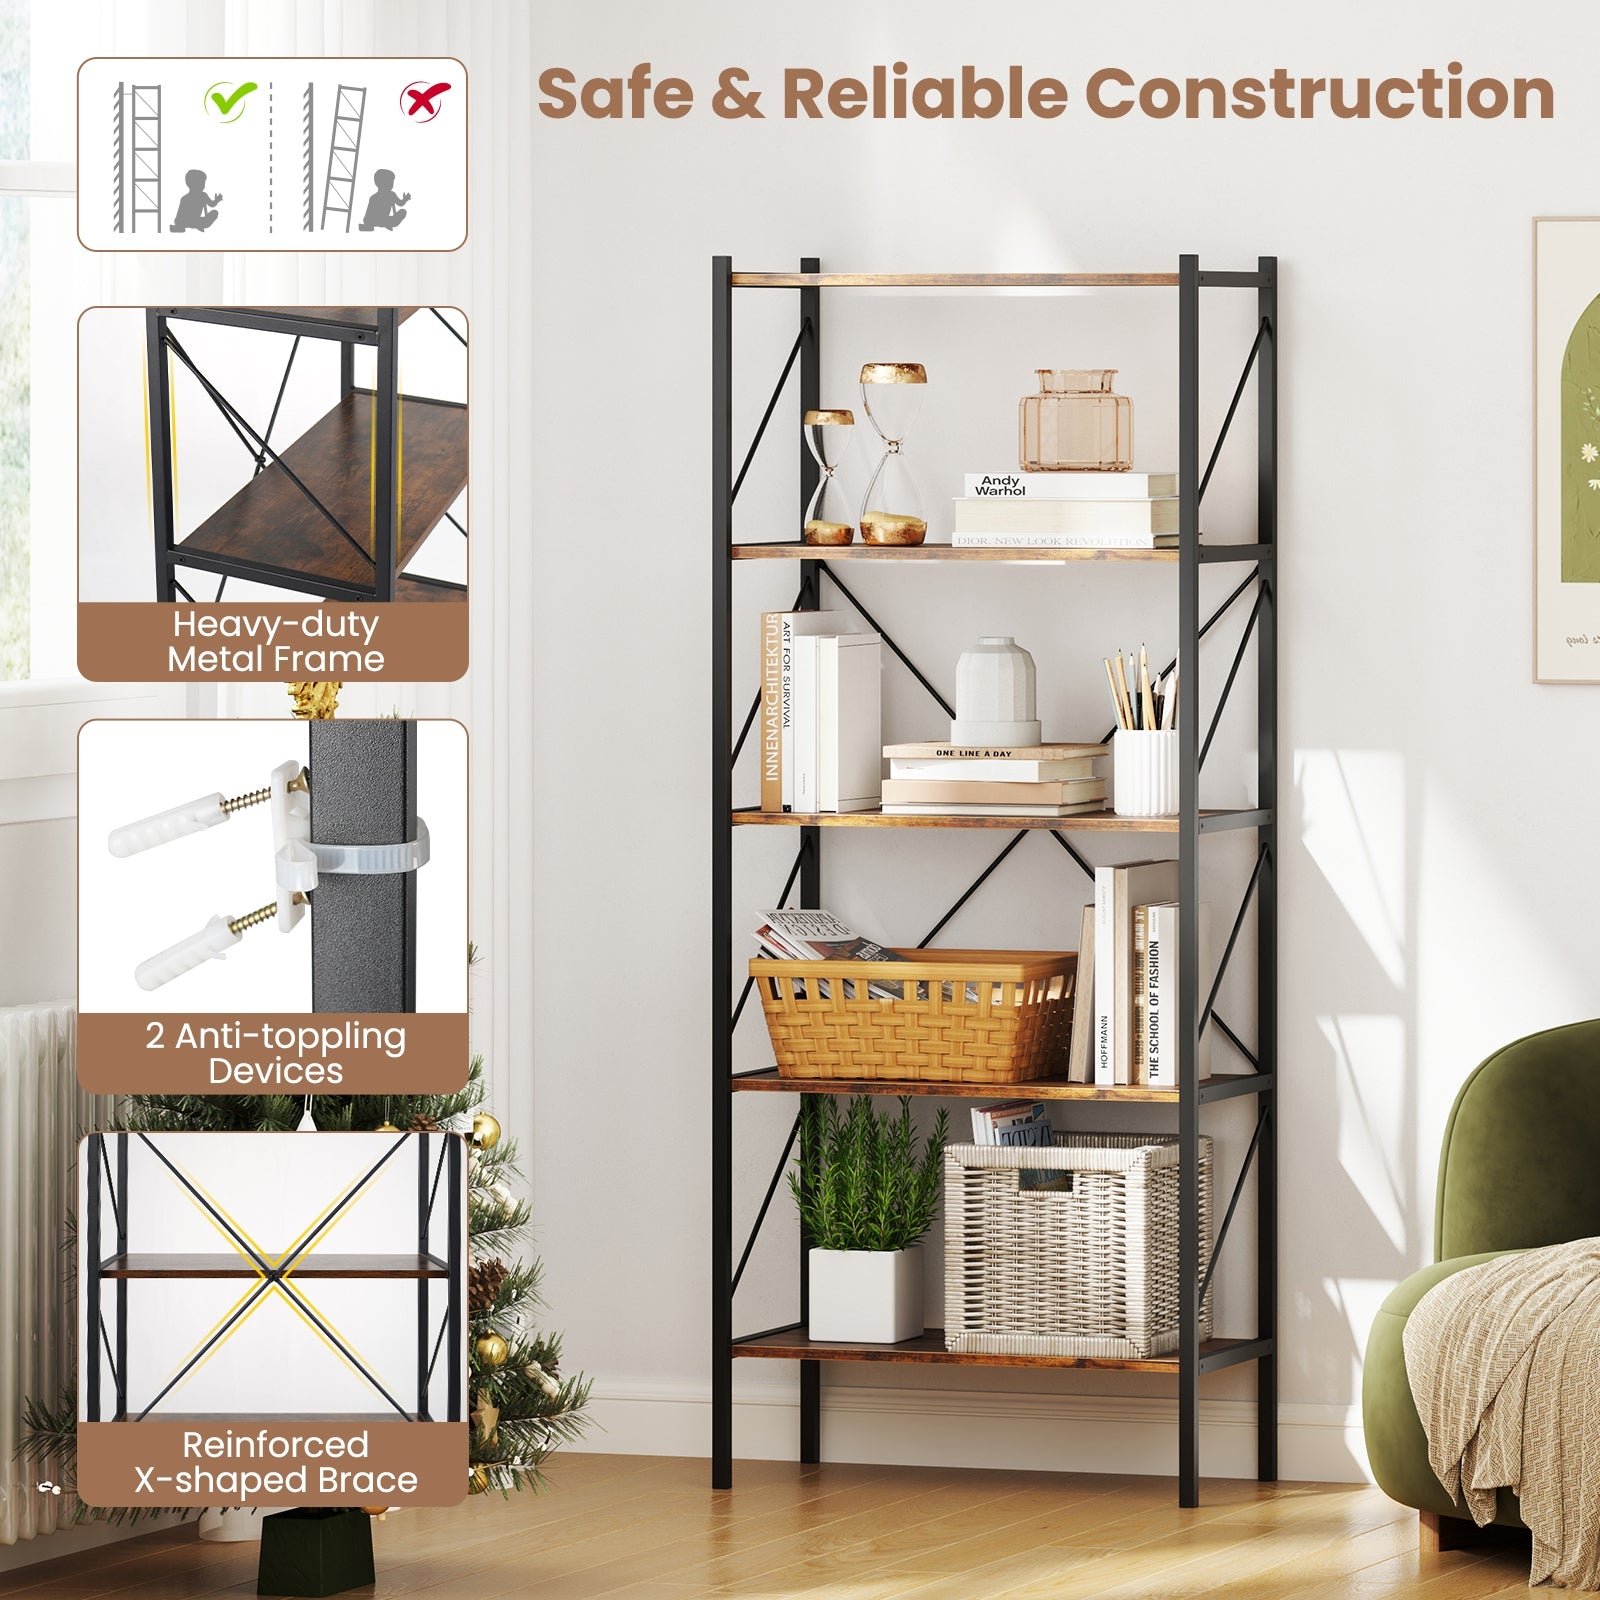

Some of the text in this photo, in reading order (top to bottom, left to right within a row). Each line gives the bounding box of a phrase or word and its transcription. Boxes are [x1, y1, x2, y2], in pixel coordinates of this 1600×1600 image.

[981, 475, 1020, 487] Andy
[975, 486, 1026, 496] Warhol
[994, 537, 1022, 545] NEW
[1027, 537, 1062, 545] LOOK
[1065, 537, 1147, 546] REVOLUTION
[766, 613, 778, 780] INNENARCHITEKTUR
[1149, 941, 1159, 1078] THE SCHOOL OF FASHION
